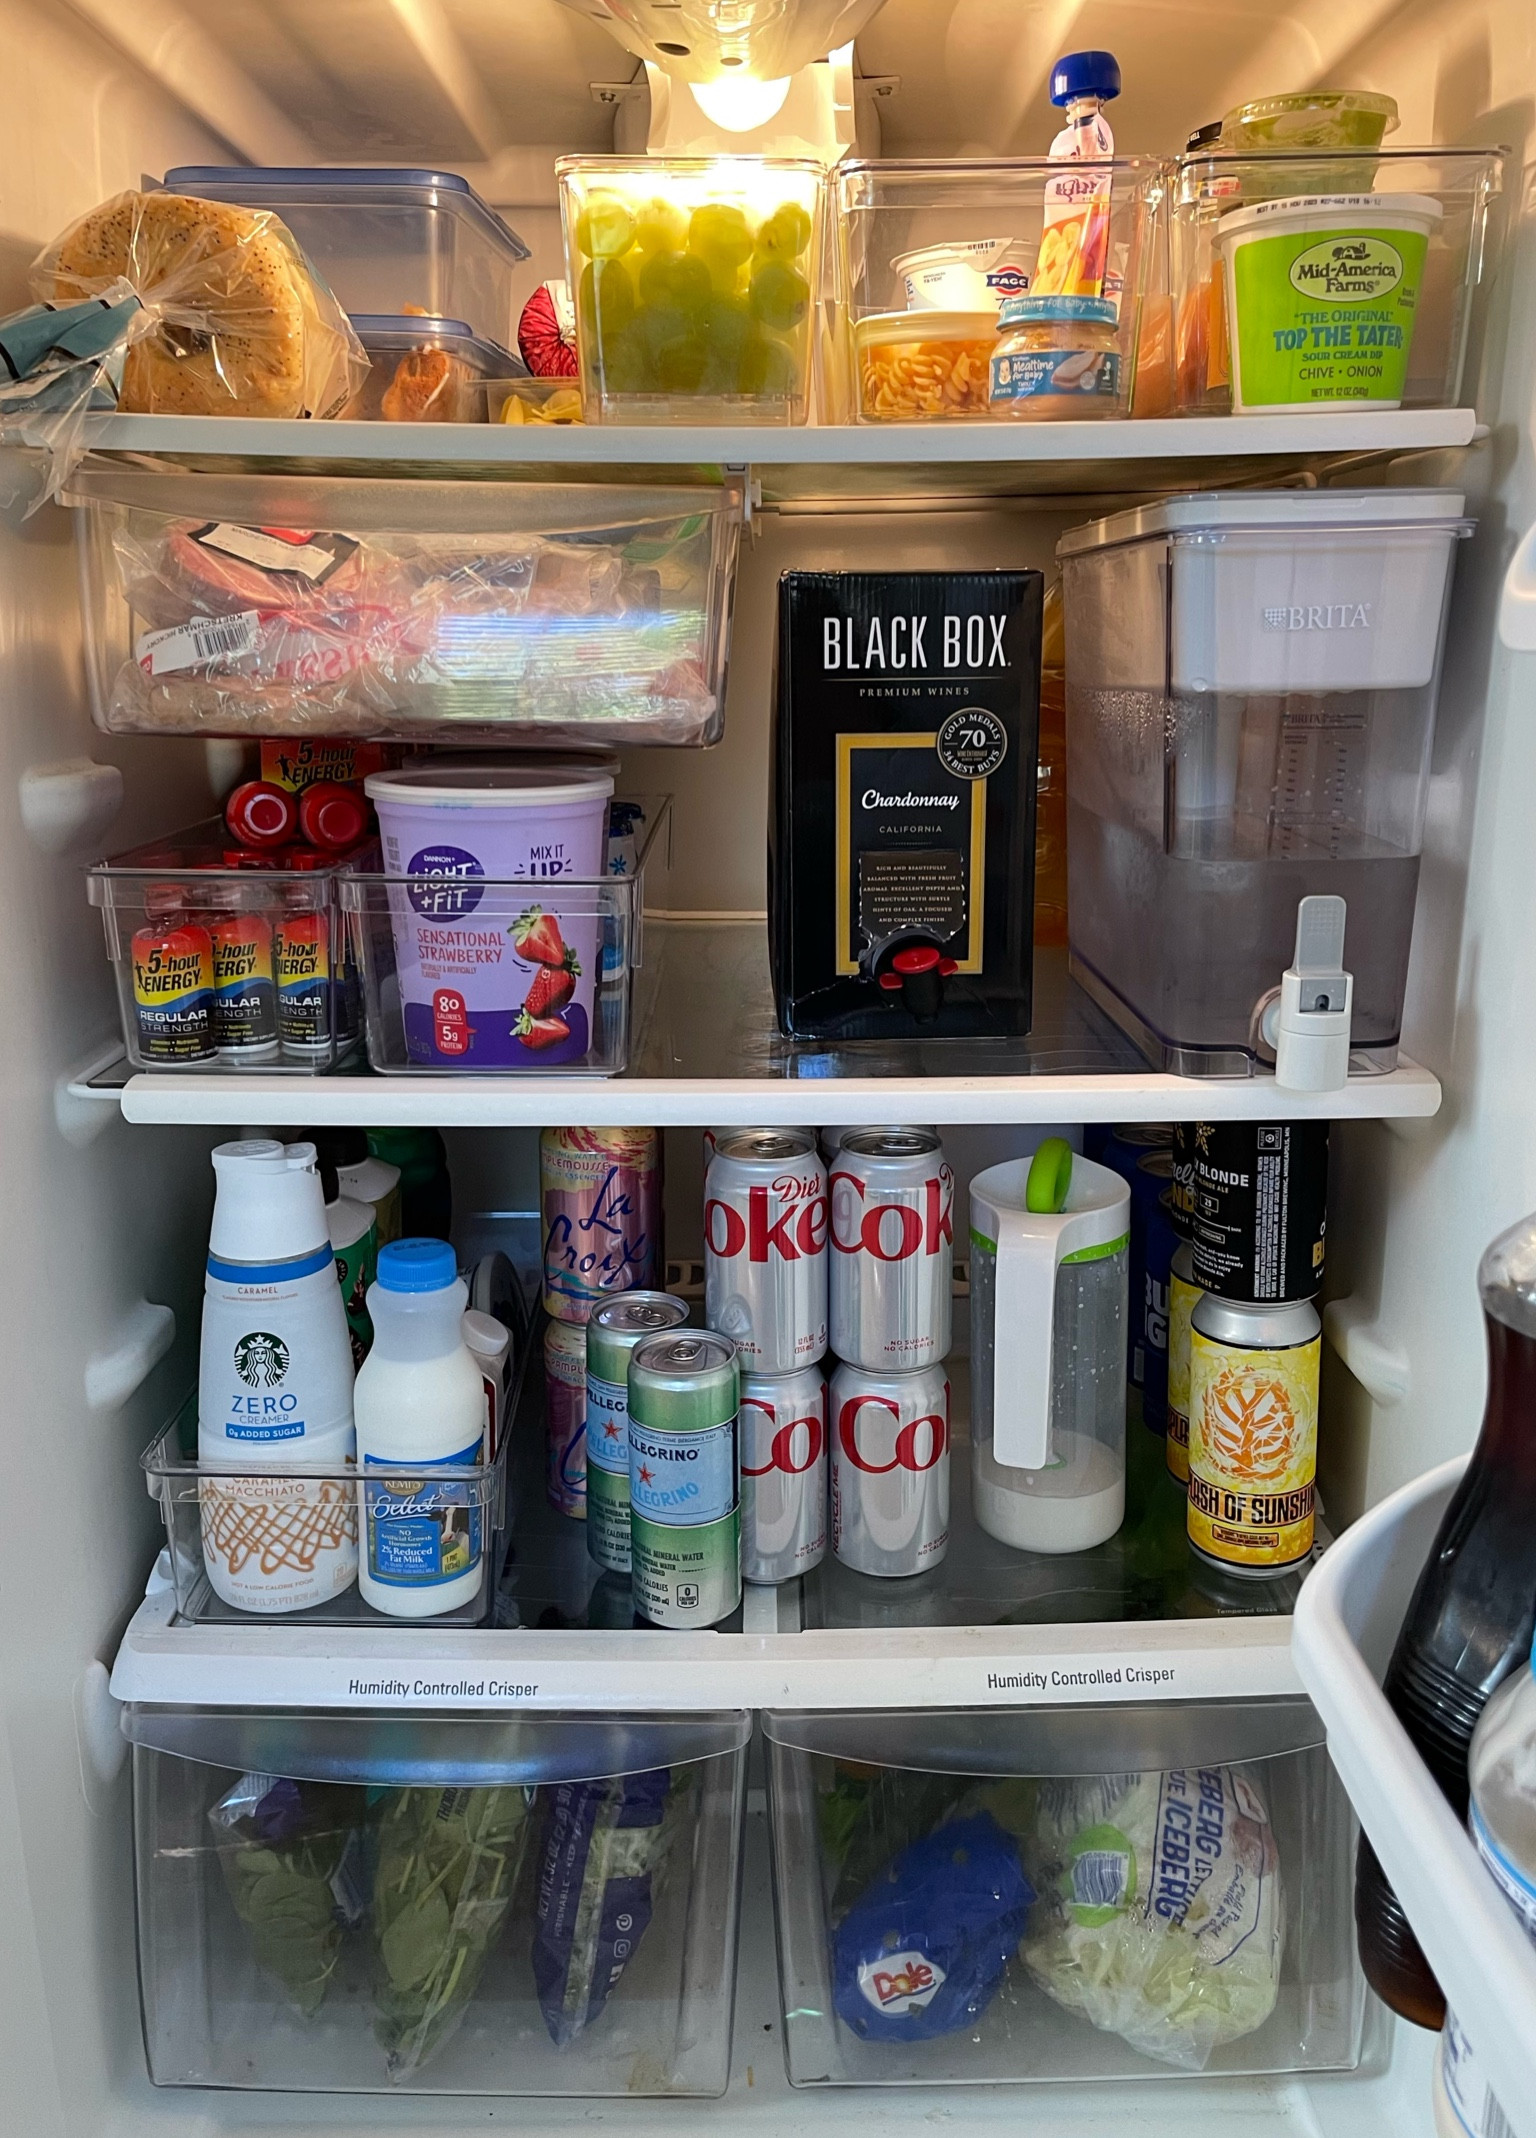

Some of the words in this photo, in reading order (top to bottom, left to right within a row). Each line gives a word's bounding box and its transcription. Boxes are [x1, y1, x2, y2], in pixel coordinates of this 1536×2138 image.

[1297, 261, 1397, 280] Mid-America
[991, 276, 1027, 287] FAGE
[1325, 278, 1380, 293] Farms
[1273, 328, 1307, 352] TOP
[1311, 325, 1352, 348] THE
[1356, 324, 1403, 349] TATER
[1302, 352, 1330, 362] SOUR
[1333, 351, 1368, 361] CREAM
[1369, 350, 1383, 360] DIP
[1013, 360, 1053, 372] Mealtime
[1299, 367, 1334, 380] CHIVE
[1346, 366, 1383, 378] ONION
[1024, 371, 1043, 381] Baby
[178, 613, 243, 635] KRETSCHMAR
[1287, 604, 1370, 630] BRITA
[824, 616, 928, 670] BLACK
[944, 615, 1008, 668] BOX
[859, 688, 921, 697] PREMIUM
[928, 687, 970, 696] WINES
[944, 716, 966, 740] GOLD
[968, 714, 1001, 740] MEDALS
[959, 729, 986, 749] 70
[298, 741, 356, 764] 5-hour
[943, 750, 955, 762] 34
[951, 759, 975, 774] BEST
[977, 749, 1000, 773] BUYS
[293, 764, 356, 784] ENERGY
[861, 789, 960, 811] Chardonnay
[879, 825, 943, 834] CALIFORNIA
[424, 854, 452, 863] DANNON
[531, 846, 555, 860] MIX
[556, 844, 564, 858] IT
[417, 928, 506, 947] SENSATIONAL
[148, 948, 201, 974] 5-hour
[418, 945, 503, 963] STRAWBERRY
[145, 968, 202, 993] ENERGY
[439, 996, 459, 1012] 80
[140, 1009, 208, 1022] REGULAR
[436, 1012, 462, 1021] CALORIES
[141, 1021, 208, 1032] STRENGTH
[442, 1026, 458, 1041] 5g
[440, 1040, 463, 1050] PROTEIN
[1200, 1163, 1249, 1188] BLONDE
[772, 1173, 821, 1203] Diet
[579, 1166, 634, 1235] La
[704, 1185, 827, 1262] oke
[829, 1171, 954, 1262] Cok
[544, 1215, 649, 1285] Croix
[238, 1286, 278, 1295] CARAMEL
[898, 1340, 935, 1352] CALORIES
[231, 1393, 298, 1415] ZERO
[239, 1414, 290, 1425] CREAMER
[839, 1380, 950, 1475] Co
[240, 1428, 271, 1438] ADDED
[273, 1426, 302, 1437] SUGAR
[225, 1484, 305, 1497] MACCHIATO
[373, 1494, 441, 1519] Select
[1189, 1478, 1220, 1517] LASH
[1224, 1493, 1246, 1523] OF
[381, 1545, 393, 1554] 2%
[393, 1547, 432, 1555] Reduced
[653, 1550, 680, 1562] MINERAL
[682, 1552, 704, 1561] WATER
[650, 1567, 665, 1576] ADDED
[660, 1562, 676, 1571] WATER
[295, 1578, 314, 1587] FOOD
[644, 1577, 668, 1592] CALORIES
[684, 1587, 691, 1596] 0
[987, 1672, 1048, 1690] Humidity
[1051, 1668, 1122, 1686] Controlled
[1126, 1667, 1175, 1684] Crisper
[349, 1679, 410, 1699] Humidity
[413, 1680, 484, 1696] Controlled
[488, 1681, 539, 1699] Crisper
[1155, 1797, 1193, 1918] ICEBERG
[1173, 1857, 1214, 1926] LETTUCE
[1211, 1911, 1240, 1939] Packed
[870, 1960, 937, 2004] Dole
